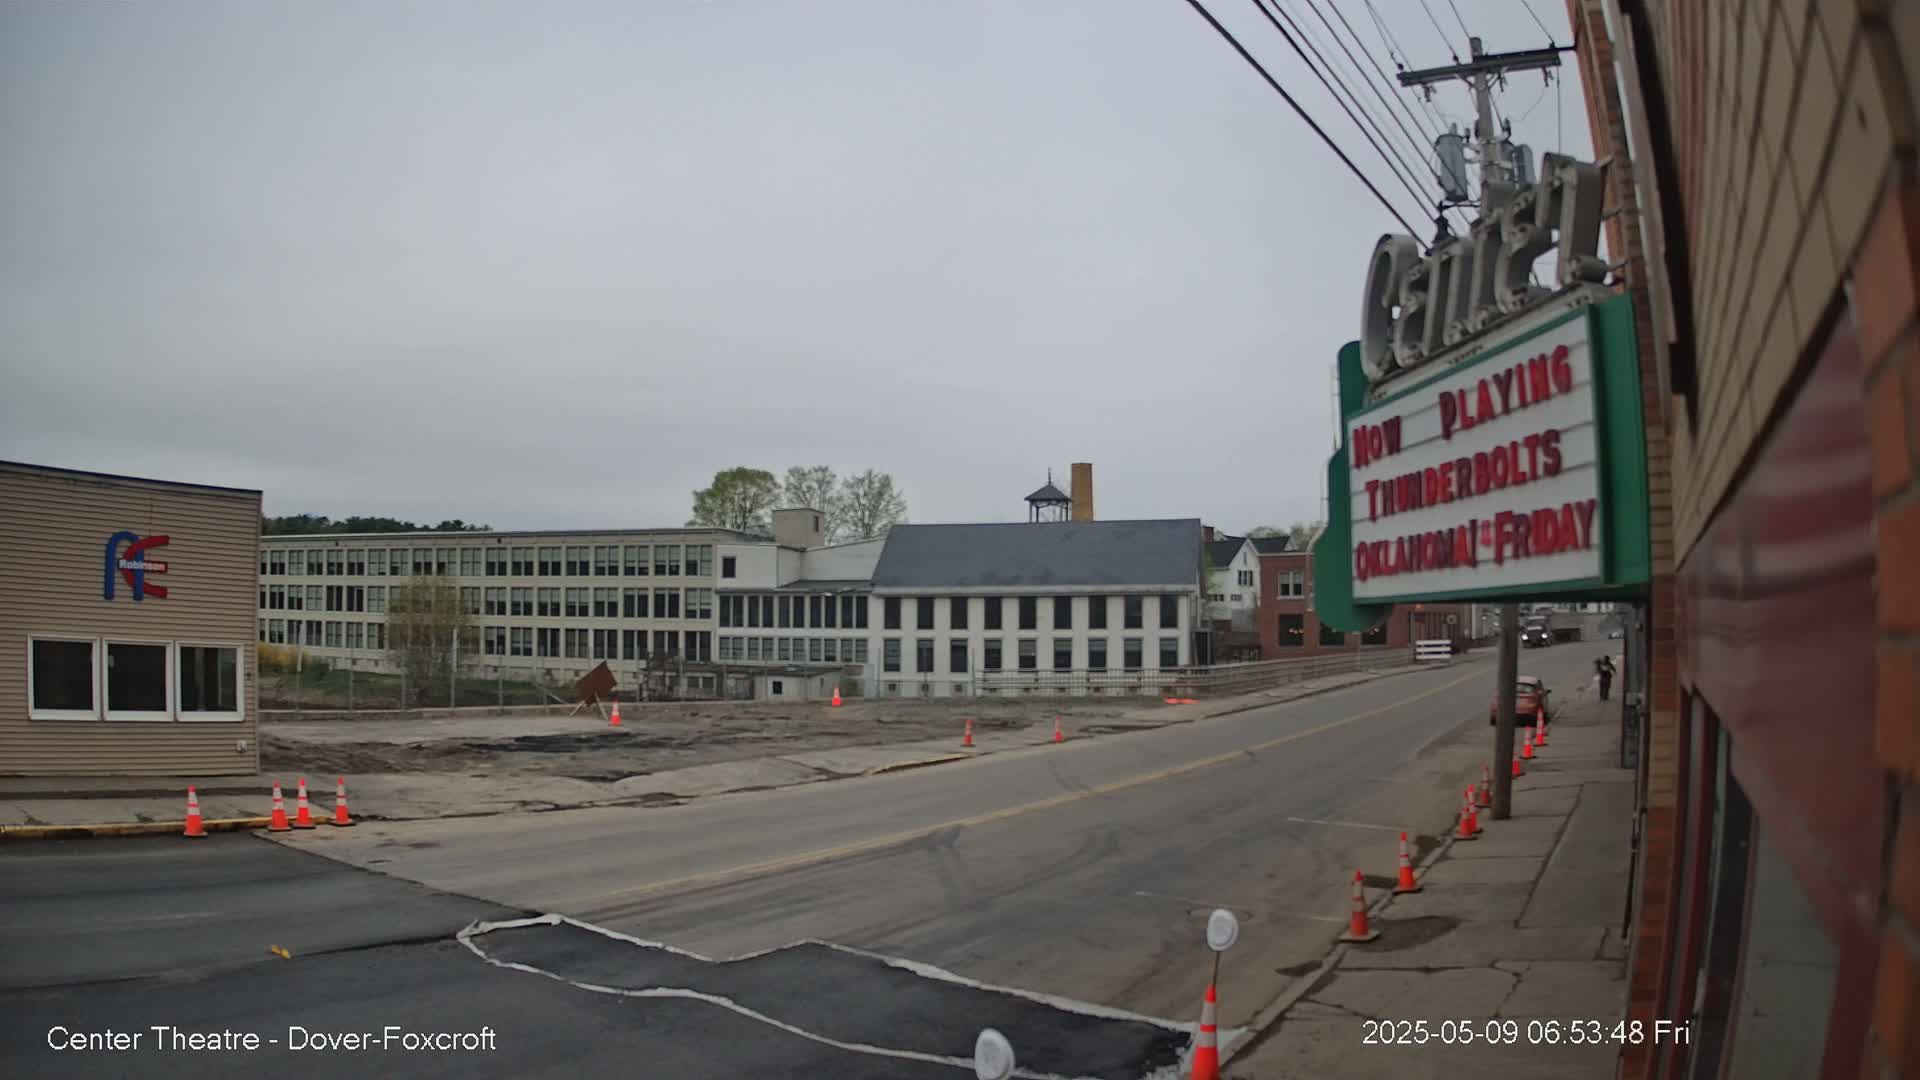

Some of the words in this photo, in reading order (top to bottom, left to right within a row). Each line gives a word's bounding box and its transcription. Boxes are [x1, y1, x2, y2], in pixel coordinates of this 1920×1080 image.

[1353, 416, 1402, 470] NOW
[1439, 344, 1572, 440] PLAYING
[1365, 429, 1562, 522] THUNDERBOLTS
[1494, 498, 1597, 566] FRIDAY
